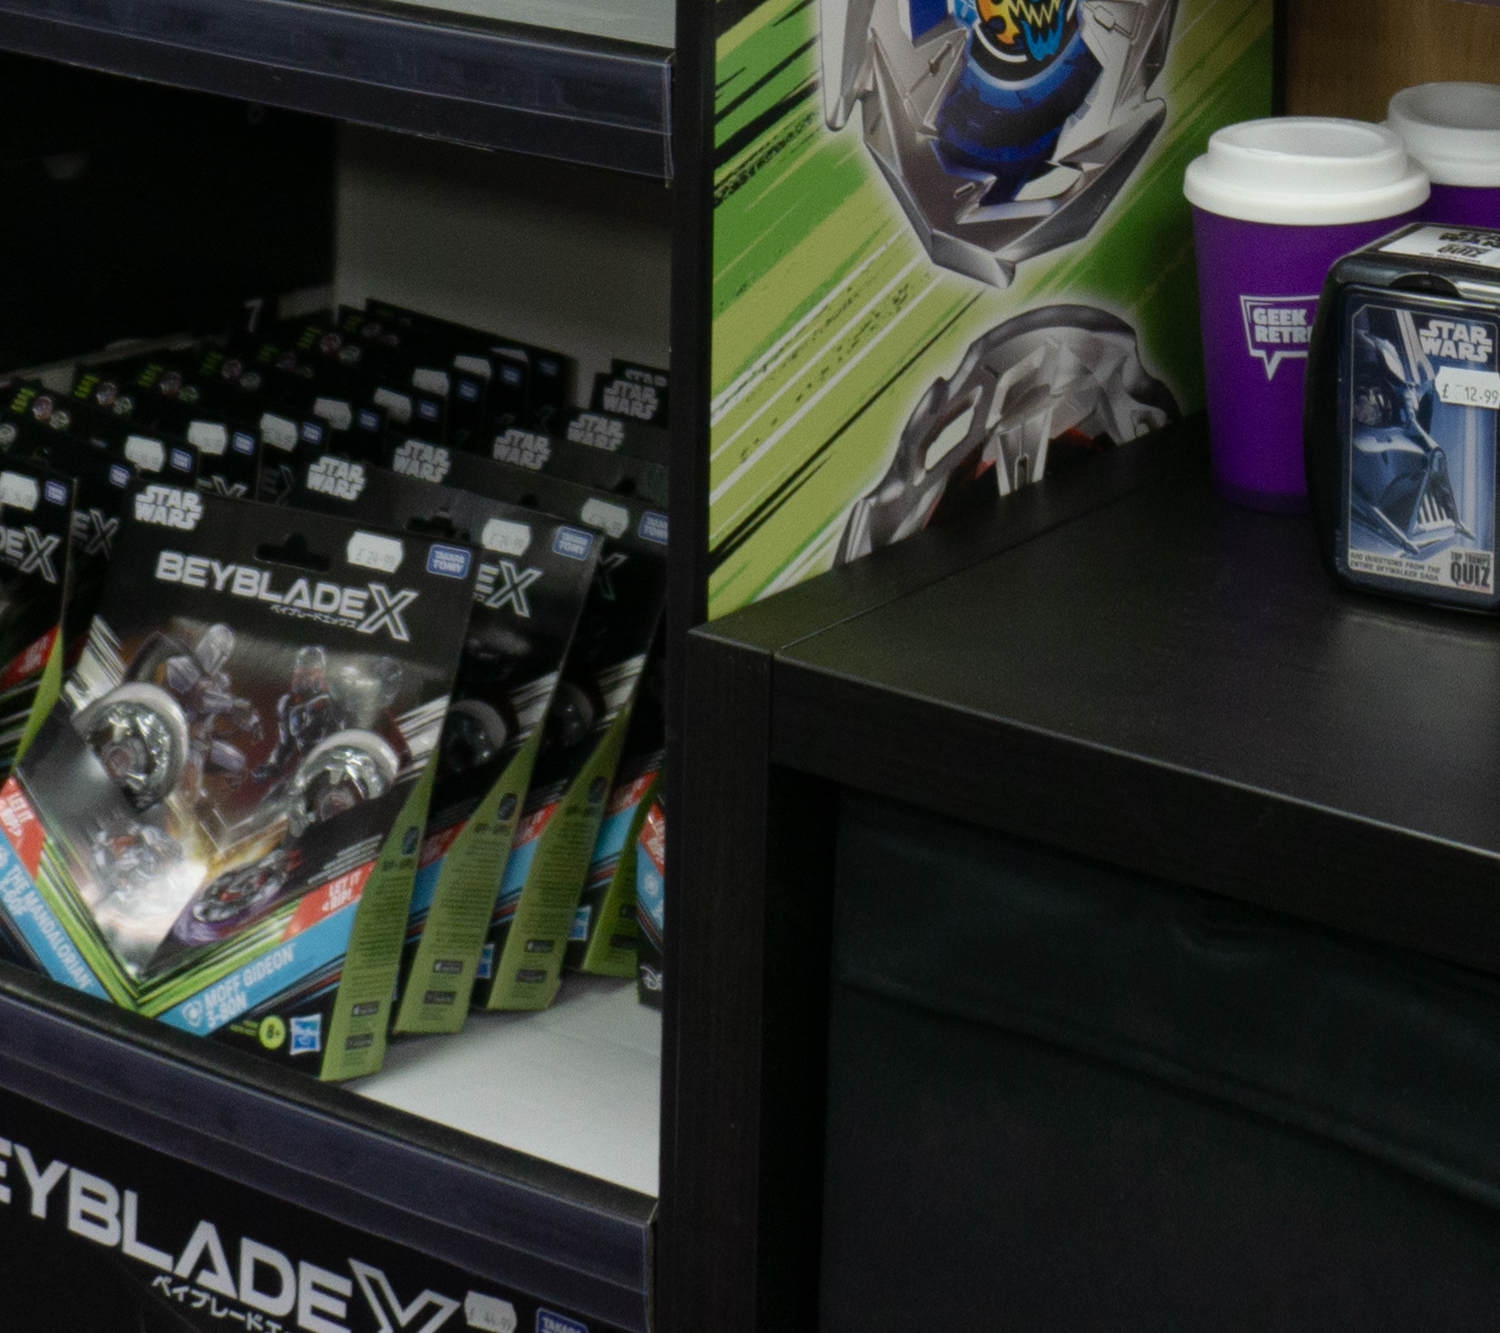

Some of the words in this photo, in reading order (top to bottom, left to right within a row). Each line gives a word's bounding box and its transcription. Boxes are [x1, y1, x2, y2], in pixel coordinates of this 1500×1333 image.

[1418, 318, 1493, 347] STAR
[1420, 337, 1494, 364] WARS
[1450, 560, 1491, 588] QUIZ
[202, 978, 244, 1013] MOFF
[241, 946, 296, 989] GIDEON
